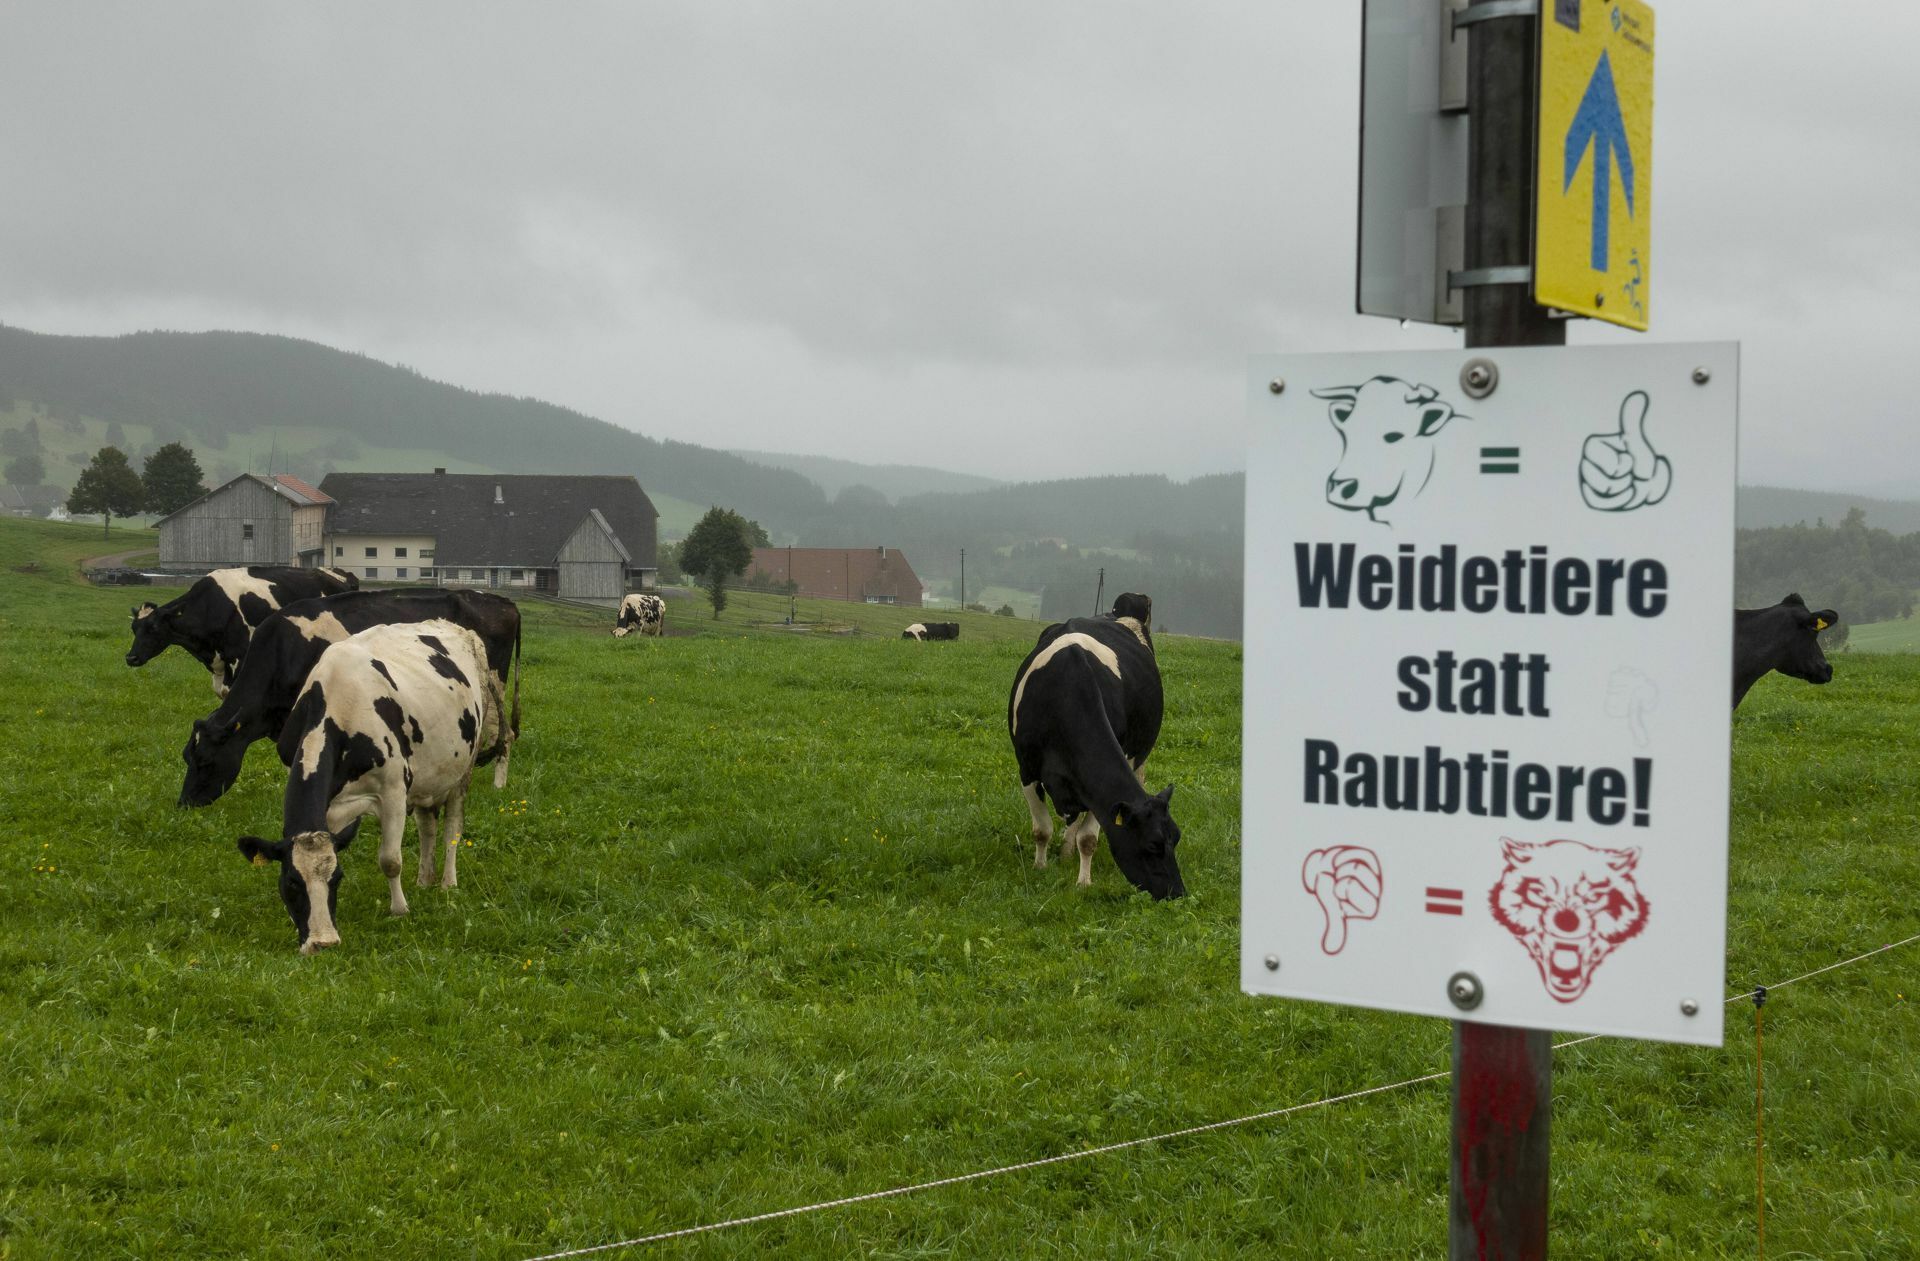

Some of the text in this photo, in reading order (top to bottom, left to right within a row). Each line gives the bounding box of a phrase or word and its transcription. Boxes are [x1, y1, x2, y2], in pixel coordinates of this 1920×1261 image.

[1294, 542, 1668, 618] Weidetiere
[1397, 650, 1551, 718] statt
[1303, 738, 1653, 828] Raubtiere!
